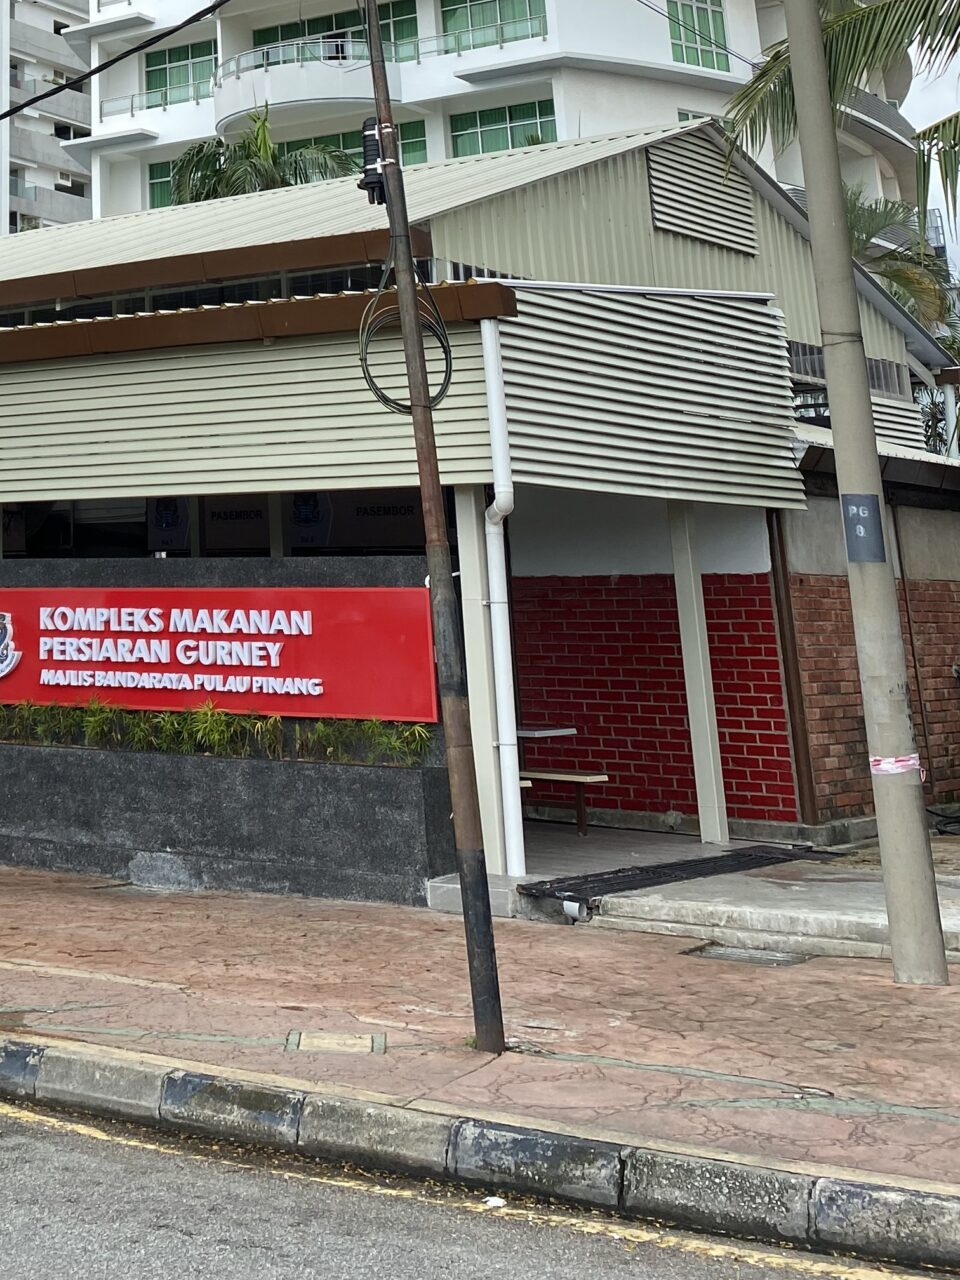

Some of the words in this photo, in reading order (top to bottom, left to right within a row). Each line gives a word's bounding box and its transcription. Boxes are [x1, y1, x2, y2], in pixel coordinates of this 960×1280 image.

[848, 505, 869, 517] PG
[39, 607, 164, 633] KOMPLEKS
[169, 608, 313, 635] MAKANAN
[39, 636, 171, 663] PERSIARAN
[176, 639, 284, 667] GURNEY
[39, 669, 94, 687] MAJLIS
[94, 670, 192, 691] BANDARAYA
[193, 673, 251, 693] PULAU
[252, 677, 324, 696] PINANG
